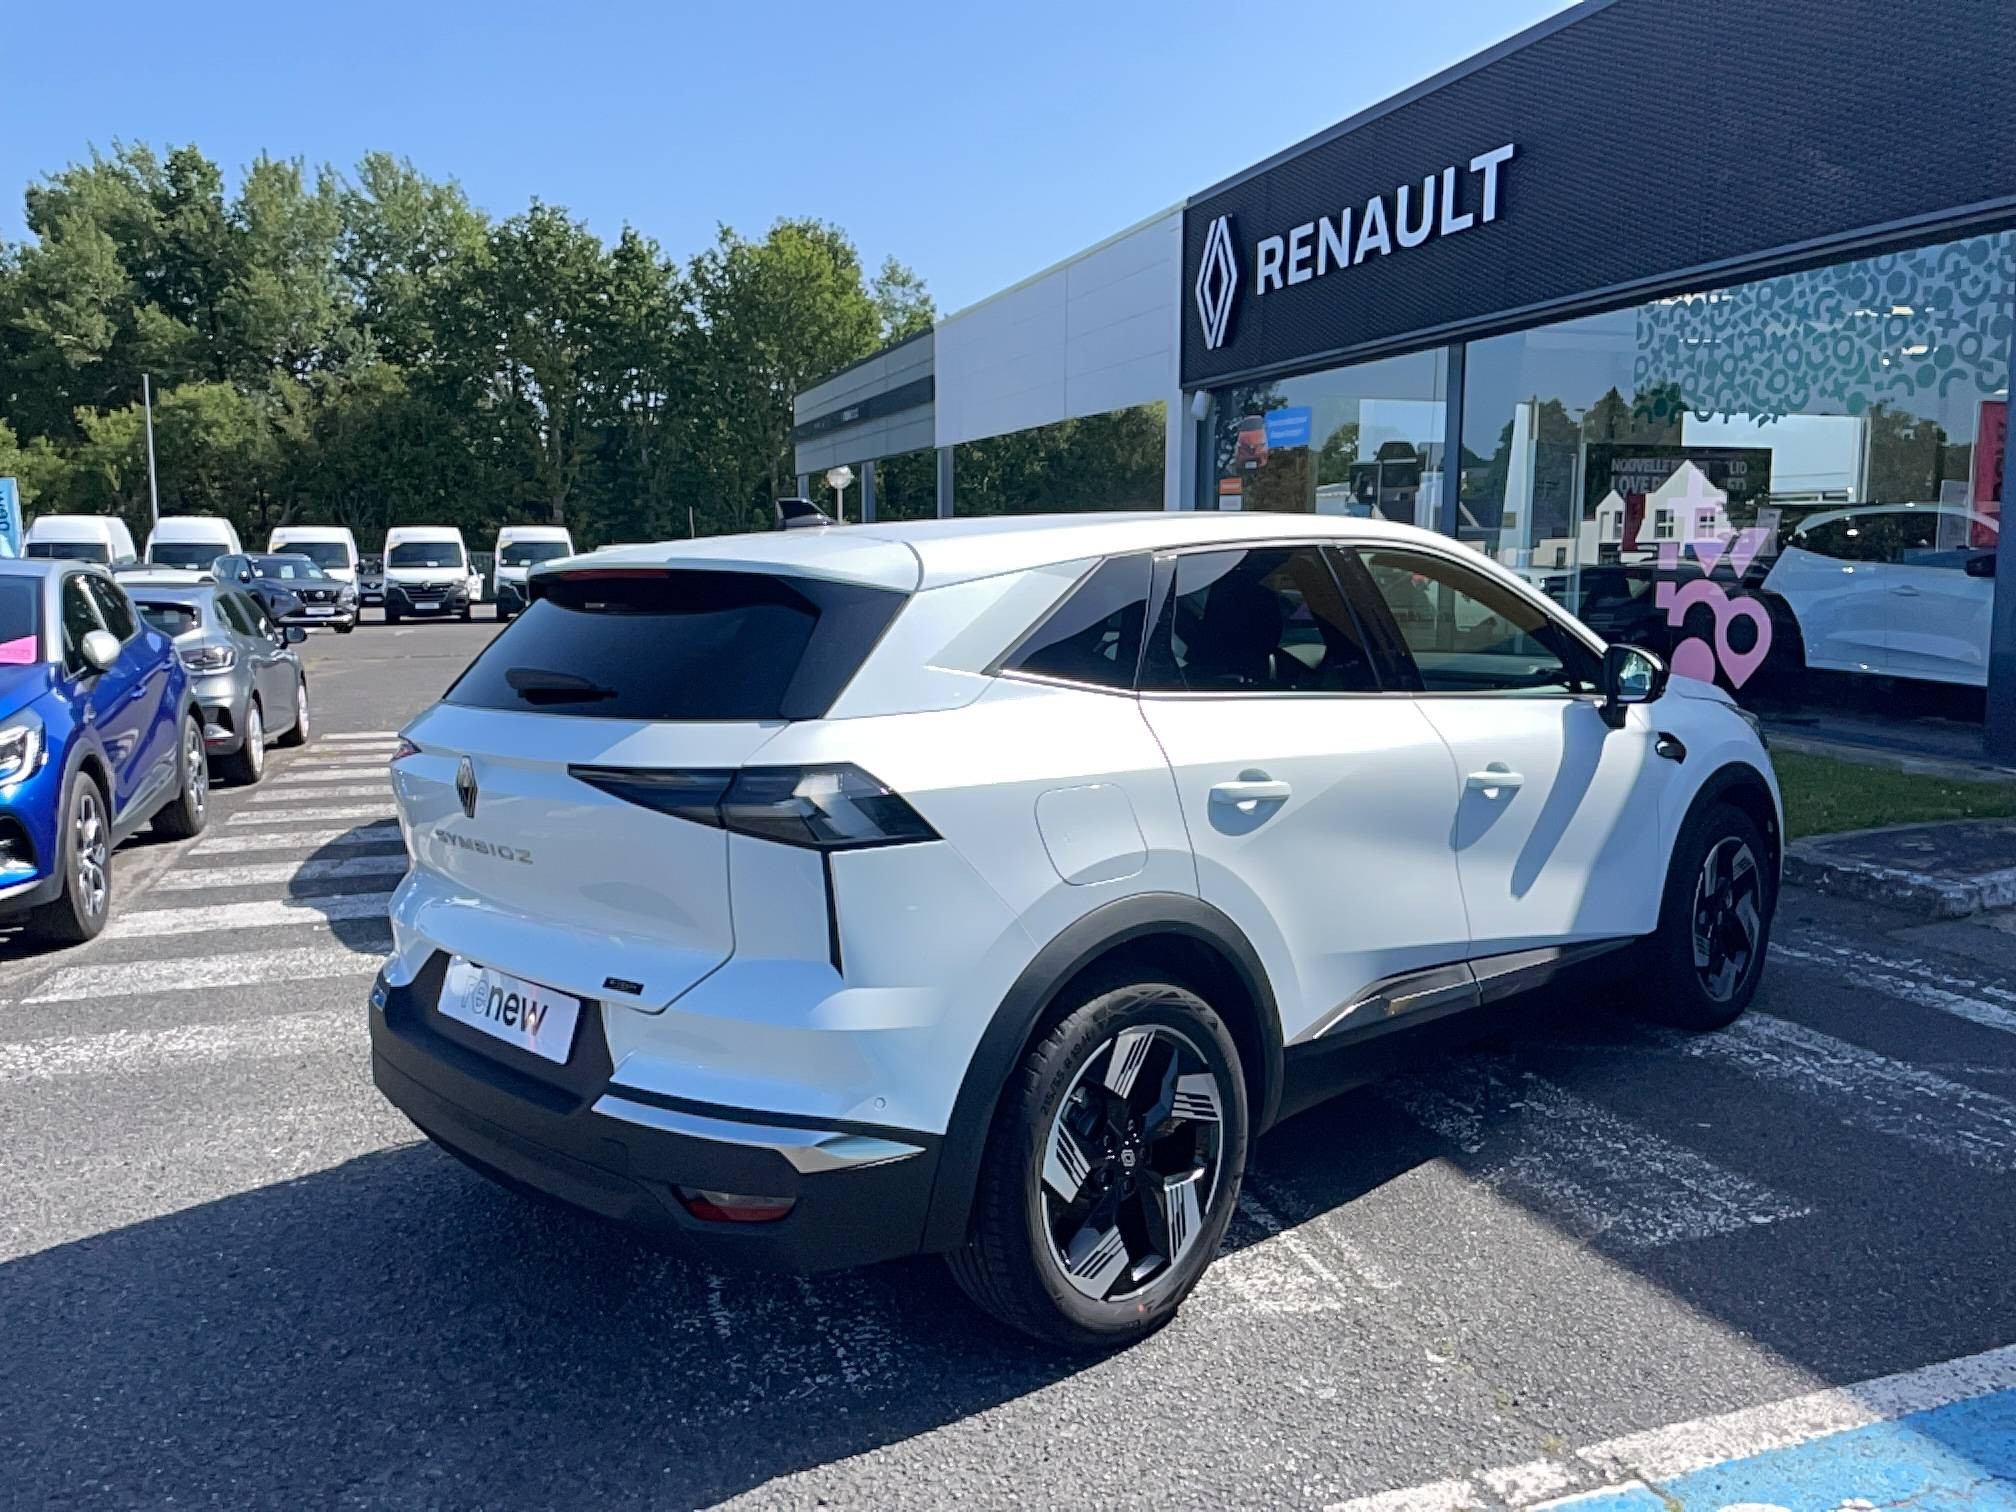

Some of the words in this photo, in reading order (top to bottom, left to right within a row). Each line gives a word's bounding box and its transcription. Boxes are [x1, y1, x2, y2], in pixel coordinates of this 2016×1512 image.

[1256, 143, 1515, 296] RENAULT
[435, 829, 534, 864] SYMBIOZ
[460, 975, 549, 1037] renew
